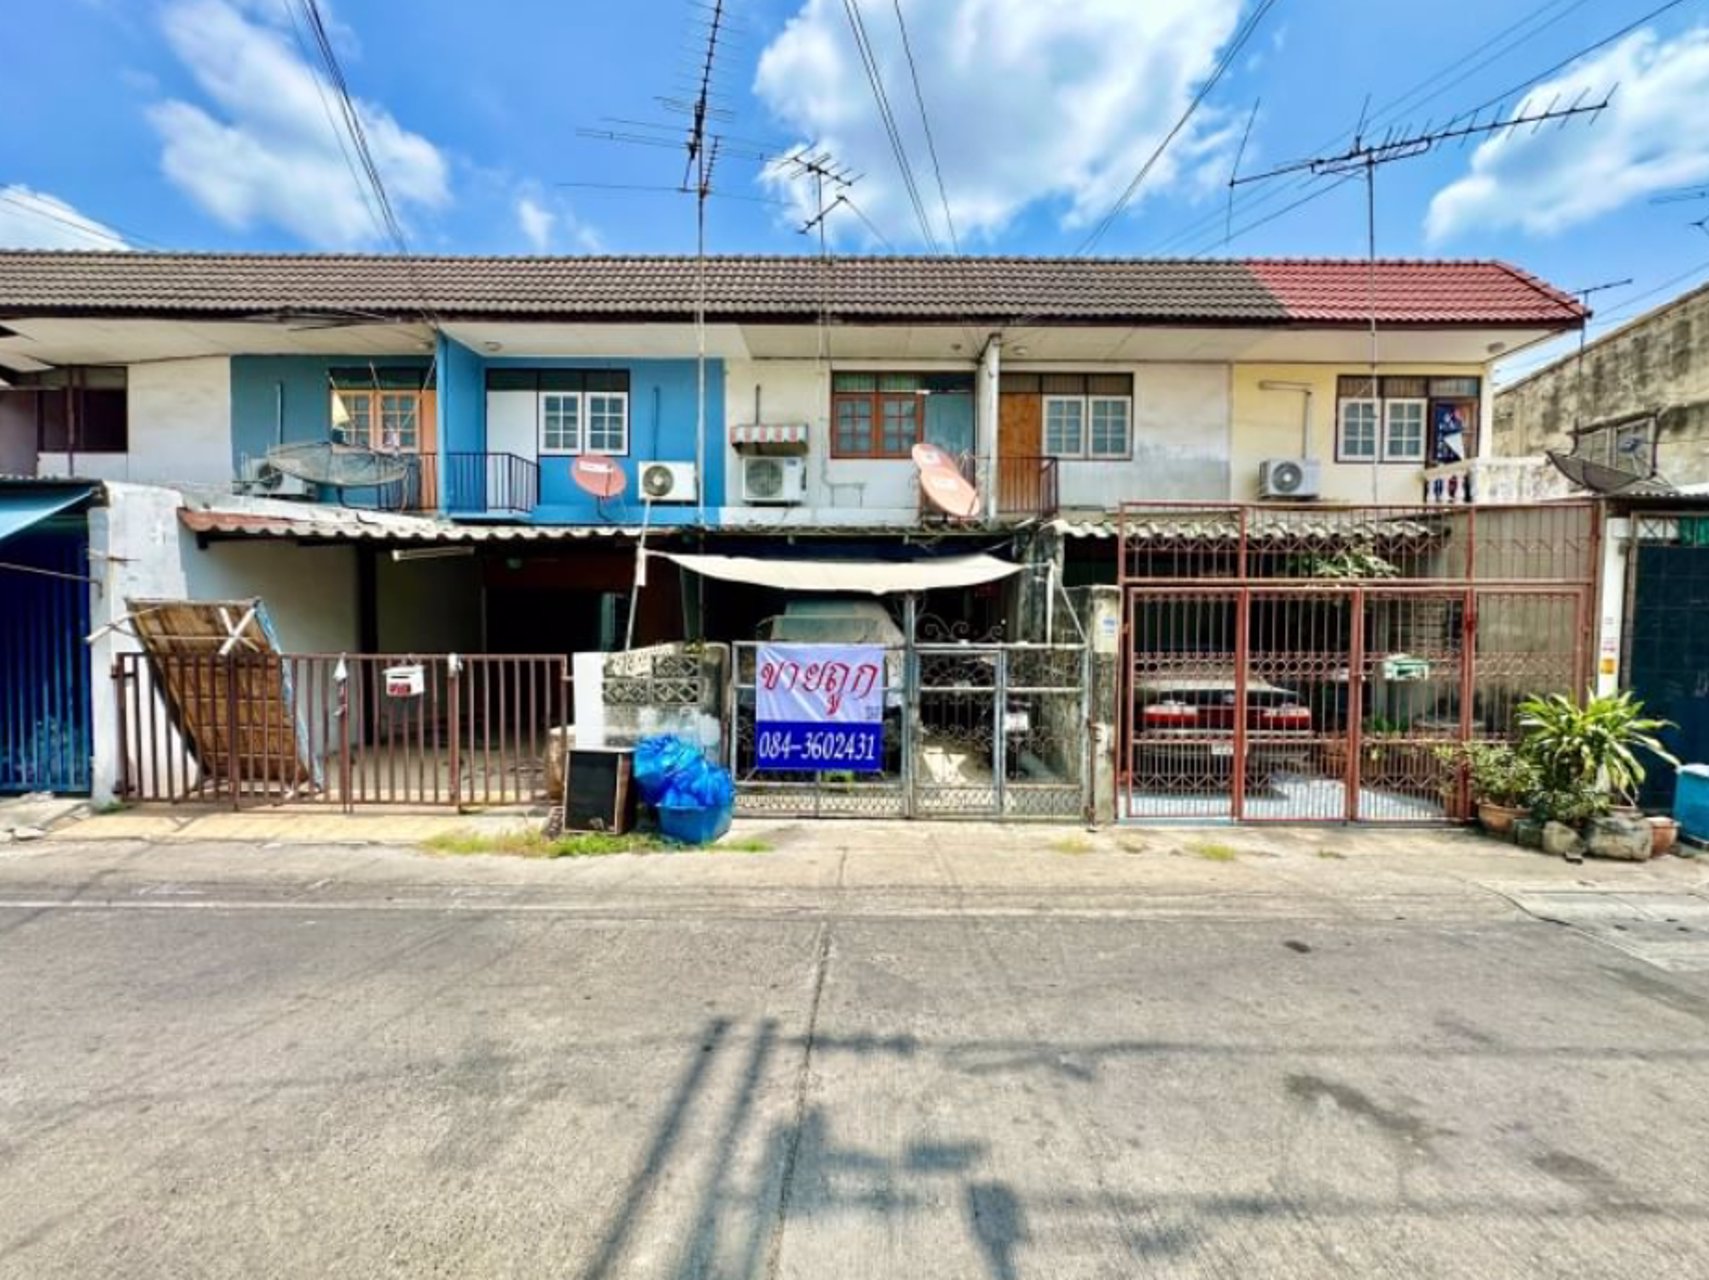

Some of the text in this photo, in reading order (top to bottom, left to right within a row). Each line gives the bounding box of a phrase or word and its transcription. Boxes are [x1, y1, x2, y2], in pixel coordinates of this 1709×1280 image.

[761, 660, 878, 716] ขายถูก
[759, 731, 875, 760] 084-3602431
